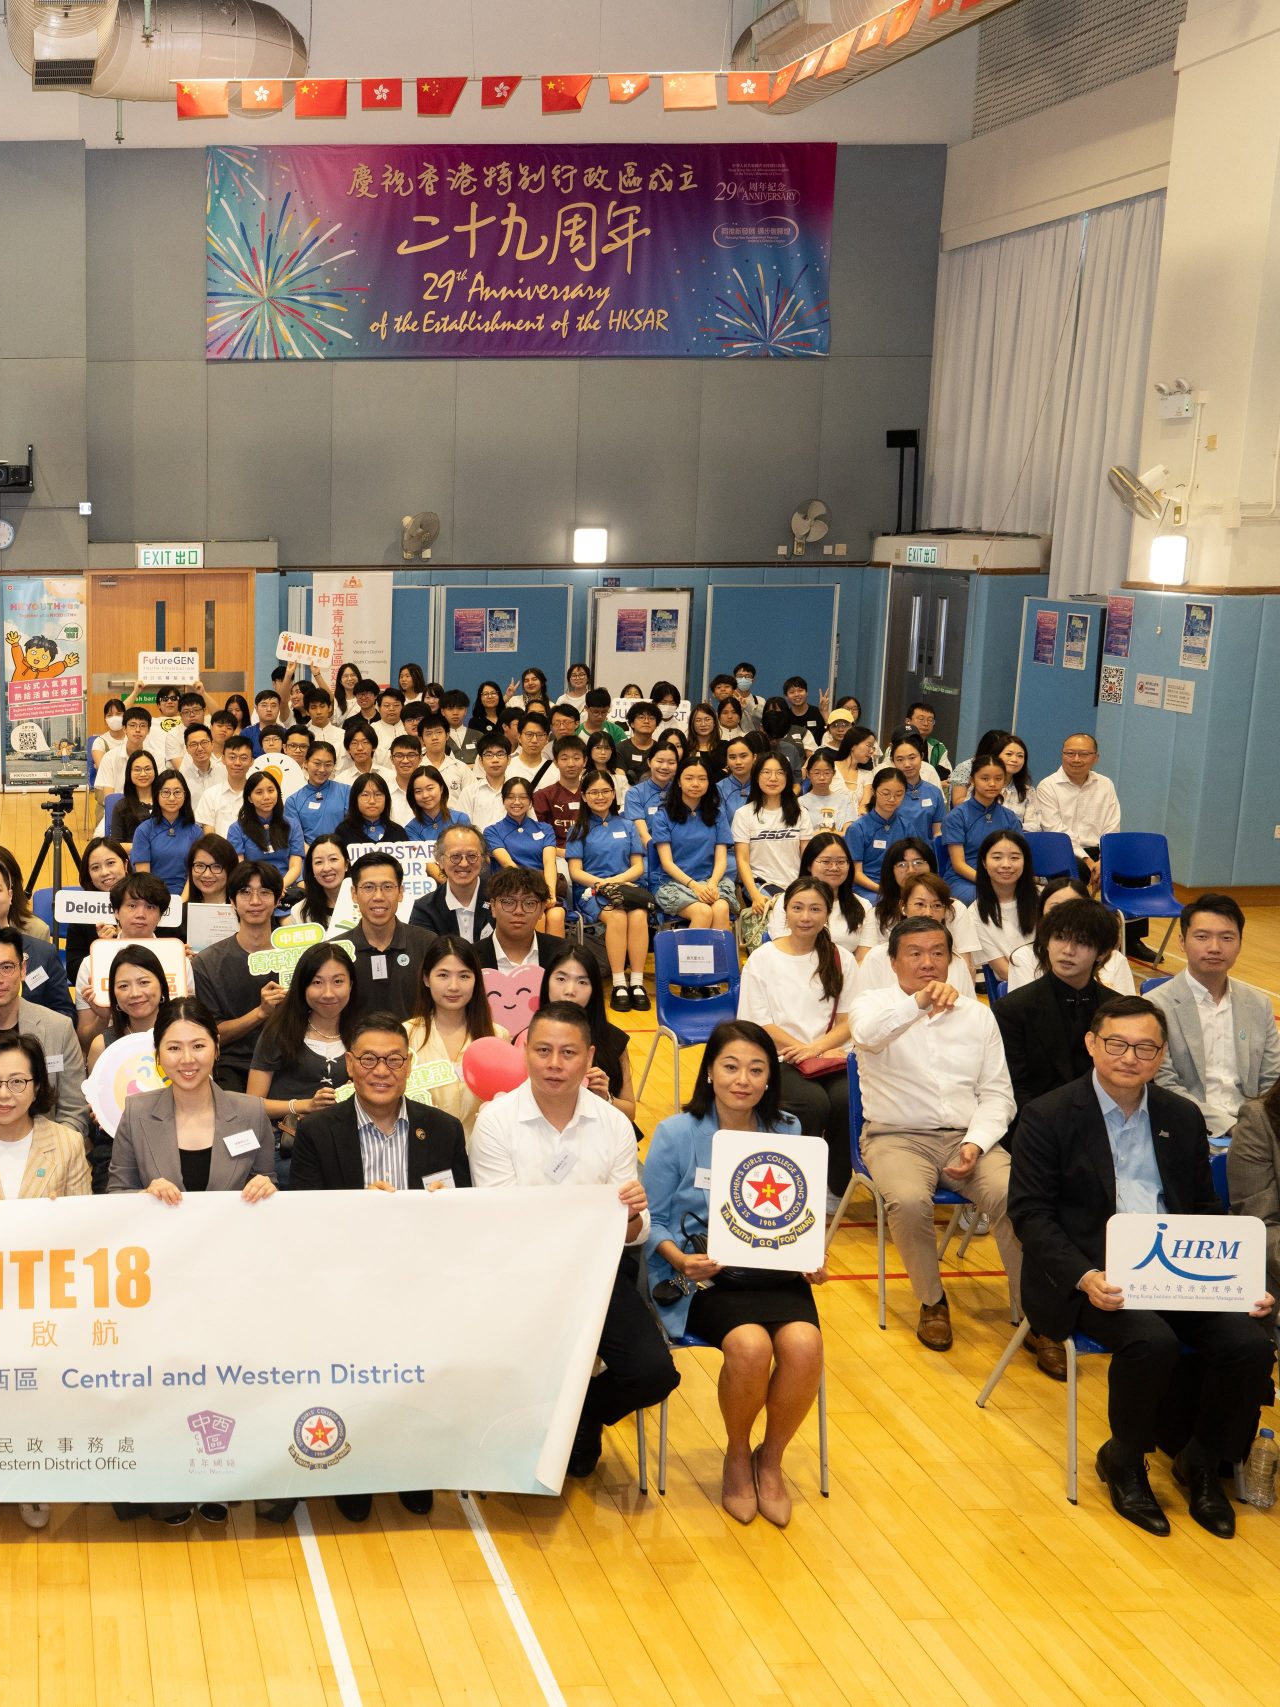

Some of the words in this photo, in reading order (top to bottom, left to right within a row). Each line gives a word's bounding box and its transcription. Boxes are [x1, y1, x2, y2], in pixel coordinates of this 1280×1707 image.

[346, 161, 698, 199] 慶祝香港特別行政區成立
[742, 191, 796, 200] ANNIVERSARY
[396, 200, 651, 275] 二十九周年
[422, 268, 468, 303] 29th
[468, 270, 611, 311] Anniversary
[370, 310, 388, 341] of
[393, 310, 419, 334] the
[422, 310, 545, 334] Establishment
[550, 308, 570, 339] of
[575, 309, 602, 332] the
[608, 308, 669, 333] HKSAR
[143, 550, 172, 566] EXIT
[175, 550, 198, 565] 出口
[908, 547, 923, 563] EXIT
[924, 548, 937, 564] 出口
[318, 592, 359, 608] 中西區
[143, 655, 195, 666] FutureGEN
[349, 845, 437, 861] JUMPSTAR
[65, 901, 114, 914] Deloitt
[766, 1154, 797, 1174] COLLEGE
[794, 1174, 804, 1199] HONG
[784, 1201, 803, 1221] KONG
[722, 1209, 731, 1220] IN
[731, 1226, 752, 1241] FAITH
[759, 1239, 773, 1247] GO
[759, 1219, 777, 1227] 1906
[1129, 1284, 1243, 1294] 香港人力資源管理學會
[61, 1366, 153, 1390] Central
[162, 1363, 207, 1388] and
[216, 1362, 321, 1387] Western
[330, 1362, 426, 1385] District
[44, 1456, 91, 1471] District
[94, 1456, 137, 1471] Office
